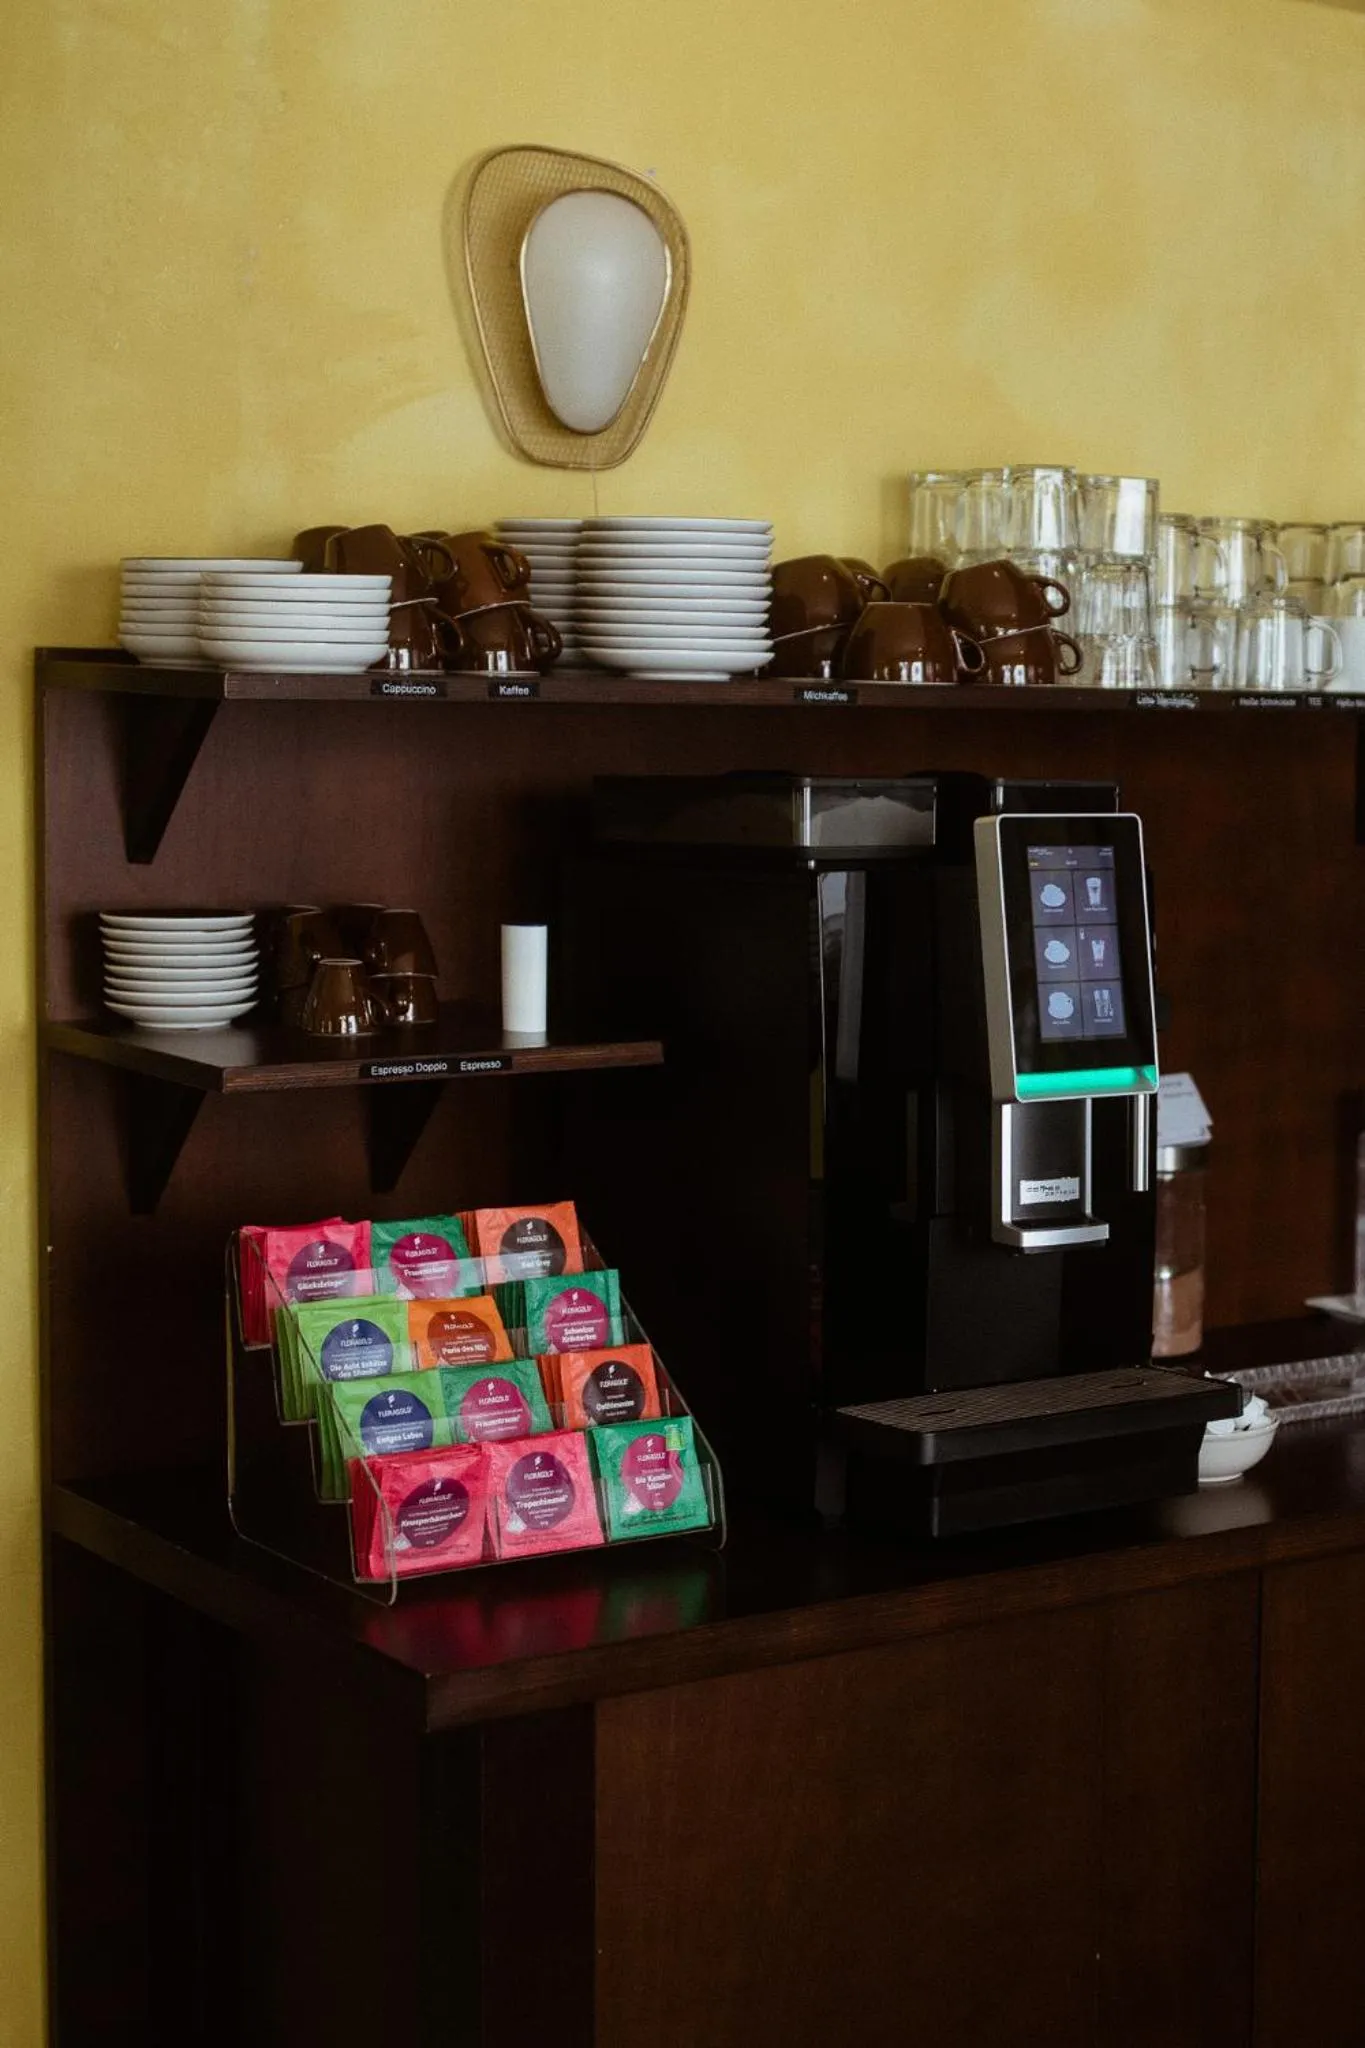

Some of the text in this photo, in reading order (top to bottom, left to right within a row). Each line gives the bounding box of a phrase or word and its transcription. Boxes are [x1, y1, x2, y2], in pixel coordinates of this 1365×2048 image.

[382, 683, 437, 696] Cappuccino
[499, 684, 530, 696] Kaffee
[803, 690, 848, 701] Milchkaffee
[371, 1061, 448, 1077] Espresso Doppio
[460, 1060, 501, 1072] Espresso
[328, 1363, 342, 1372] Die
[402, 1431, 424, 1441] Leben
